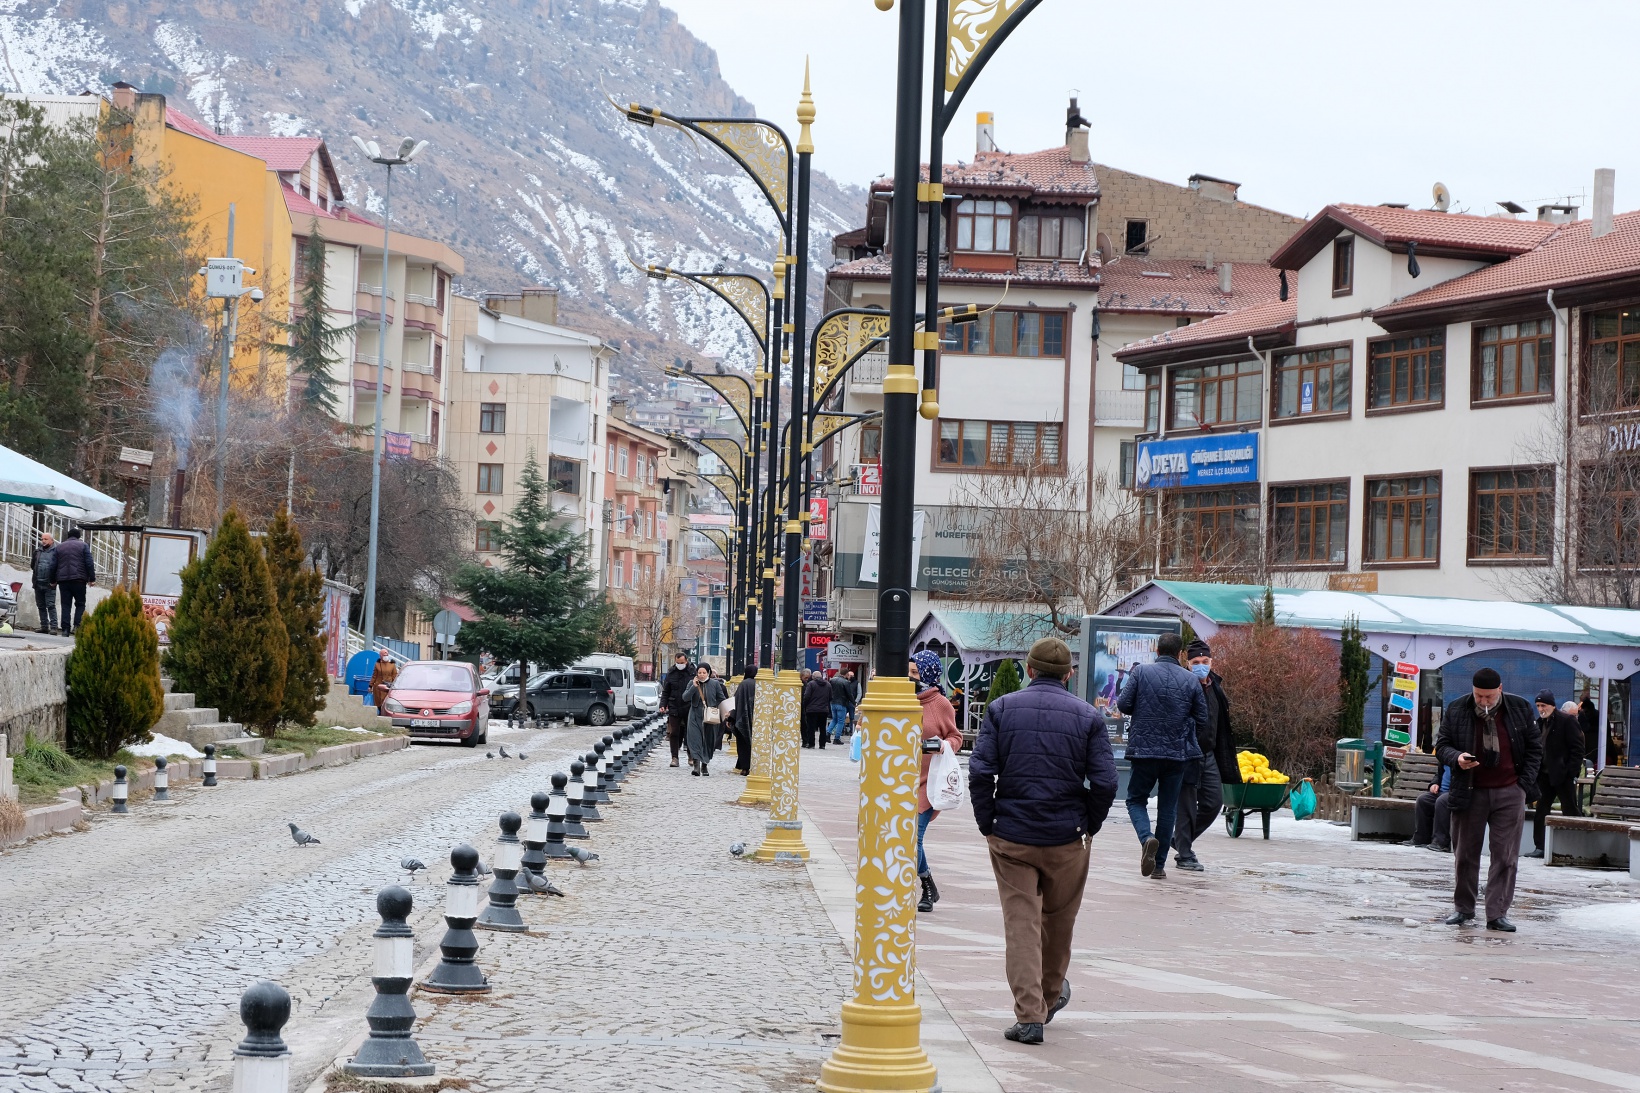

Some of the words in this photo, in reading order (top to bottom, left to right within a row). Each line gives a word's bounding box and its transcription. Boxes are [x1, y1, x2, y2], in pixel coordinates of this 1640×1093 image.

[1151, 452, 1189, 475] DEVA
[1197, 467, 1214, 477] MERKEZ
[1214, 466, 1224, 477] İLÇE
[1224, 464, 1250, 476] BAŞKANLIĞI
[862, 484, 881, 495] NOT
[809, 523, 826, 537] OTER
[946, 523, 973, 531] GÜÇLÜ
[922, 566, 976, 578] GELECEK
[142, 597, 166, 605] TRABZON
